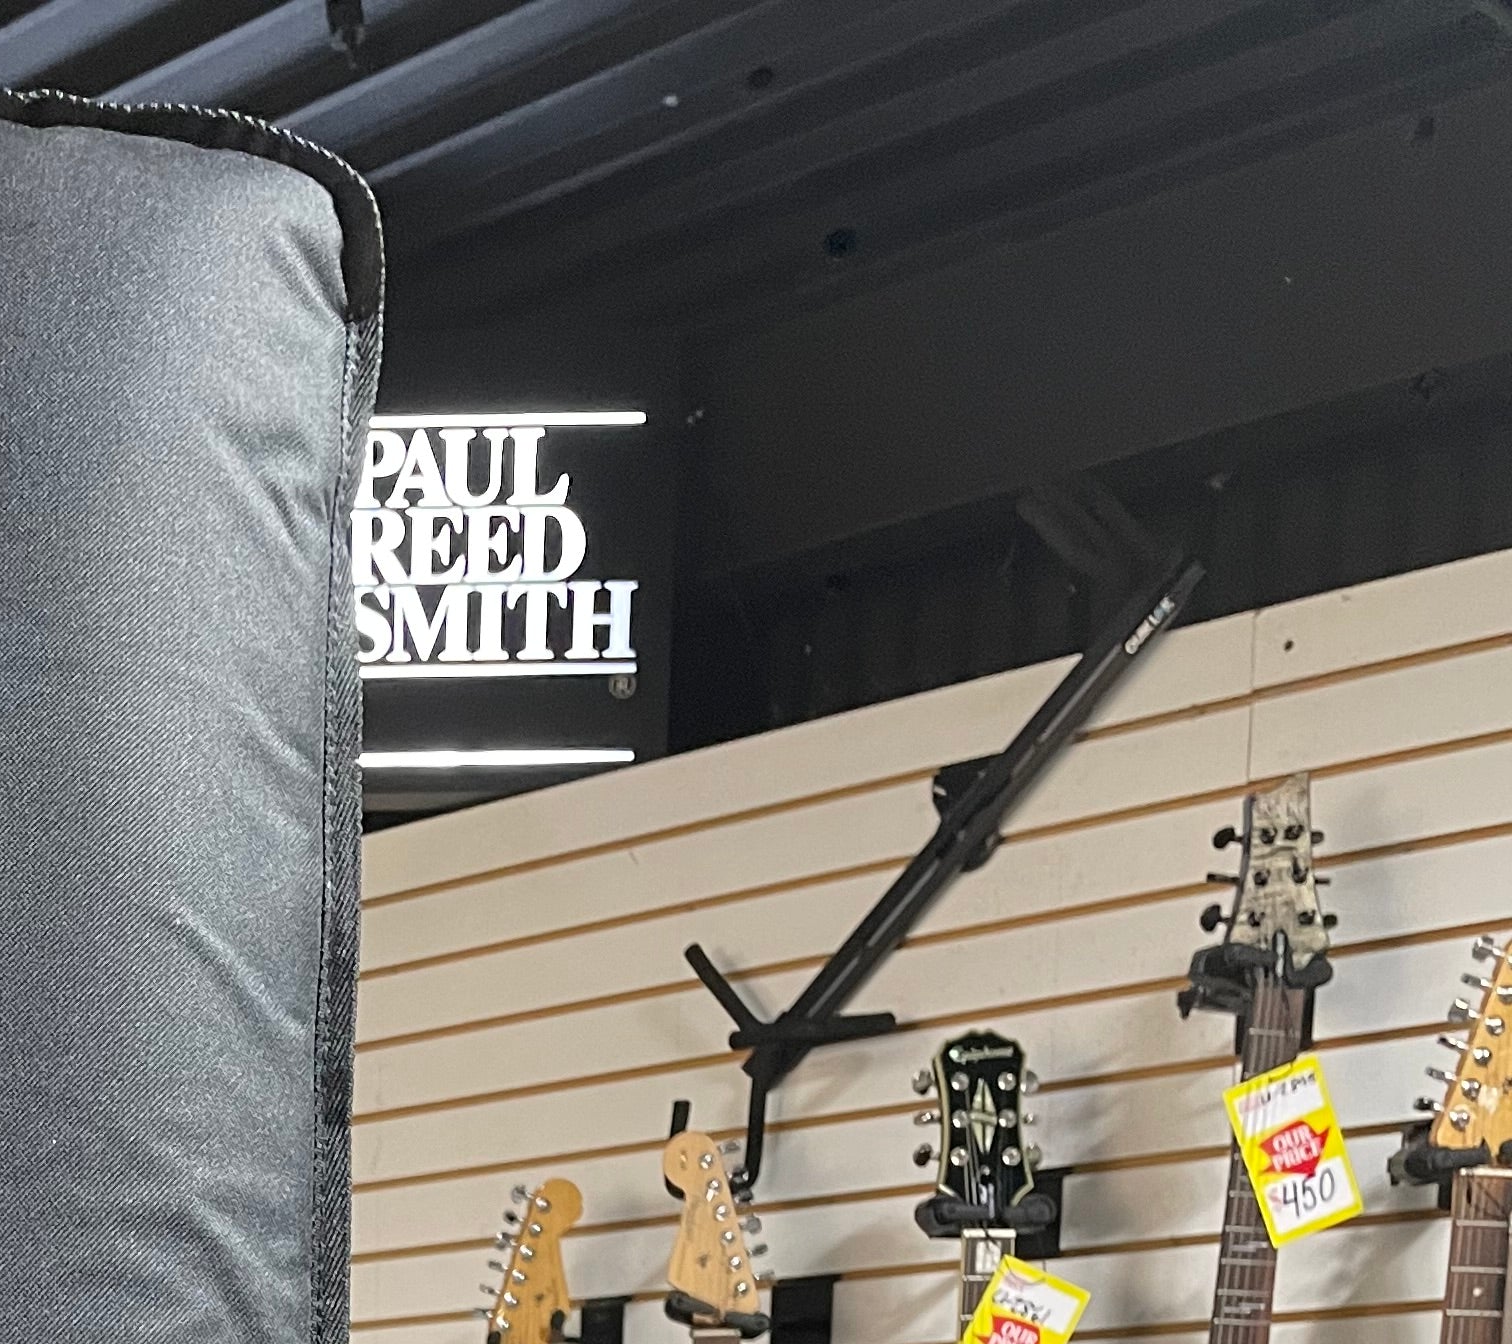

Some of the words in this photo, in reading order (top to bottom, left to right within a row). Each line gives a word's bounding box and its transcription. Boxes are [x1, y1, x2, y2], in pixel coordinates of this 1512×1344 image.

[354, 427, 569, 508] PAUL
[350, 505, 586, 585] REED
[354, 580, 638, 663] SMITH
[1272, 1123, 1312, 1151] OUR
[1272, 1136, 1322, 1172] PRICE
